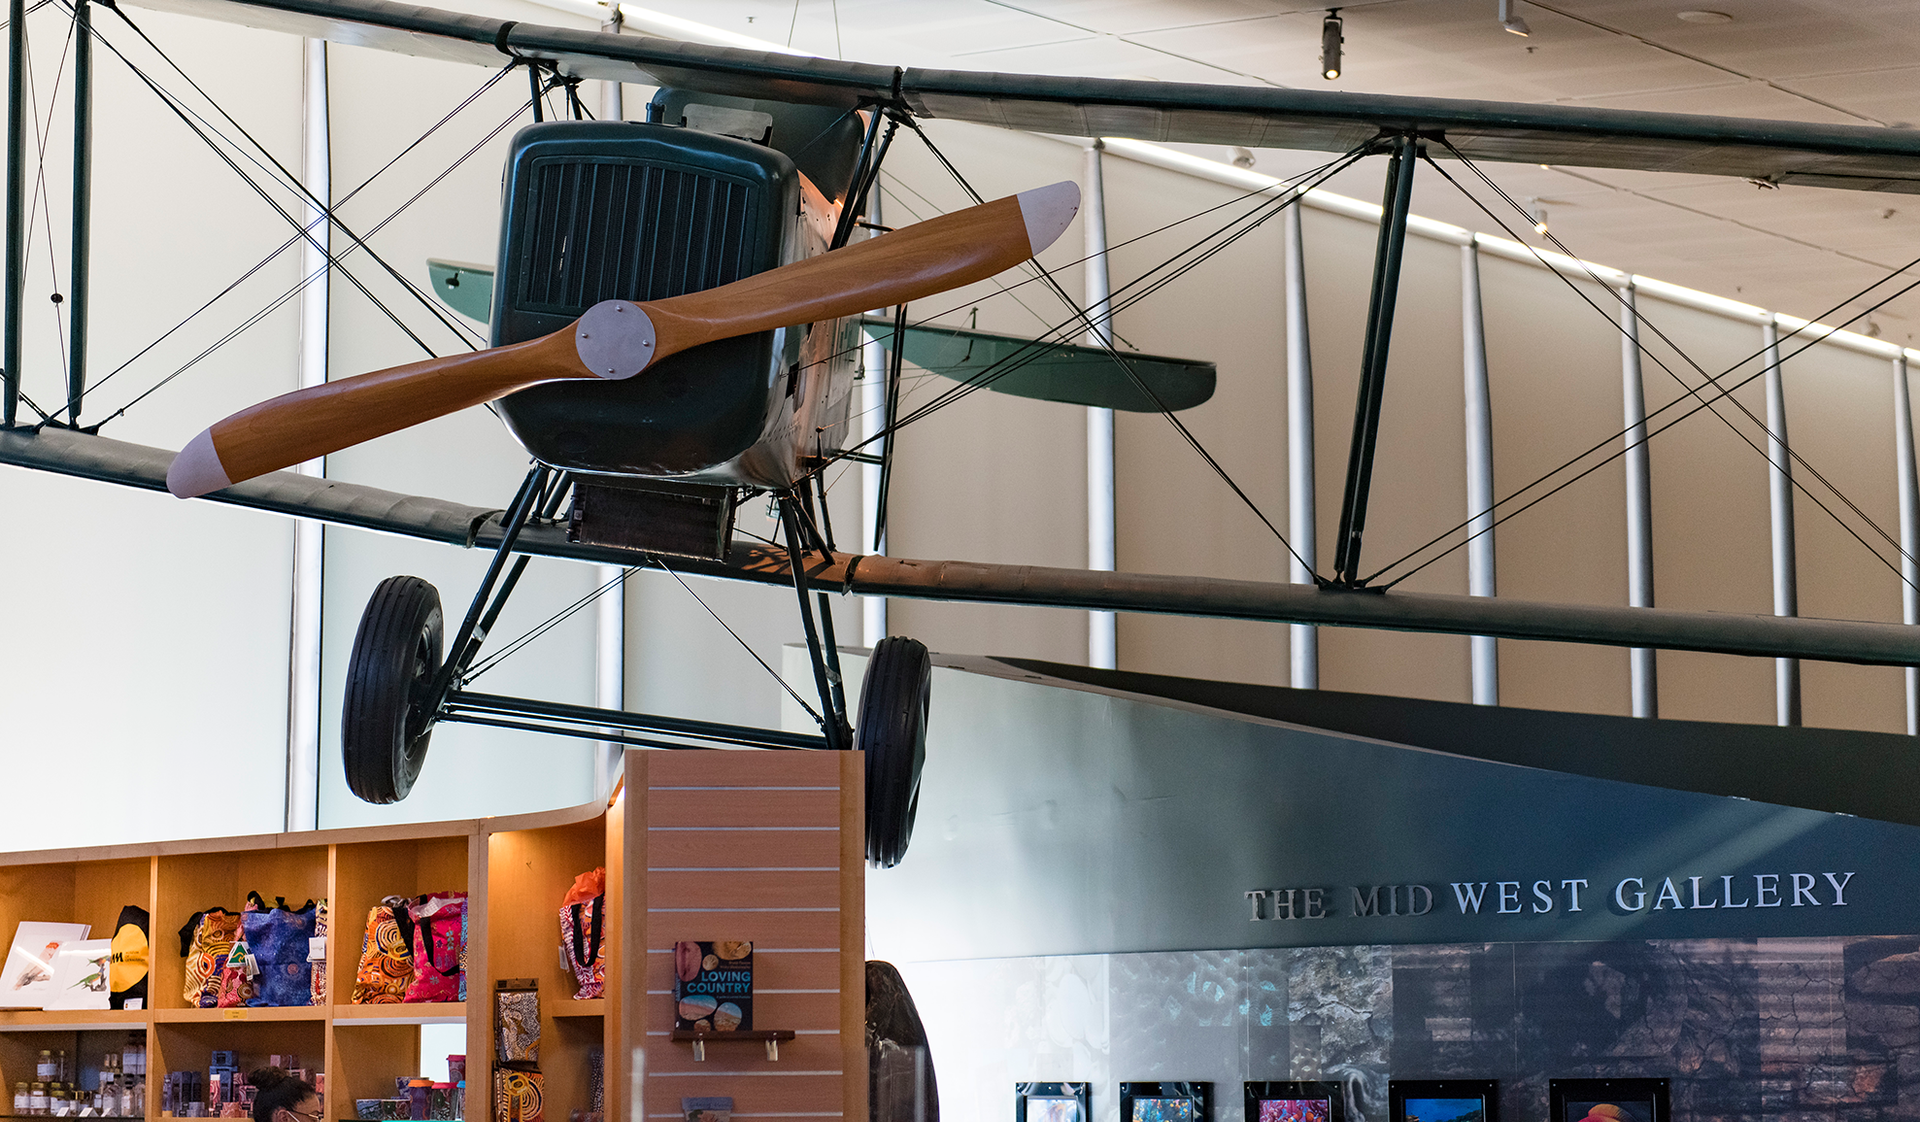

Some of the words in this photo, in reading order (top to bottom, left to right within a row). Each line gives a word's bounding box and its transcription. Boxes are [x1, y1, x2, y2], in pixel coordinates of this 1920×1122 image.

[1244, 888, 1326, 922] THE
[1349, 884, 1434, 918] MID
[1450, 879, 1589, 915] WEST
[1615, 872, 1856, 912] GALLERY
[701, 971, 751, 982] LOVING
[687, 982, 751, 993] COUNTRY
